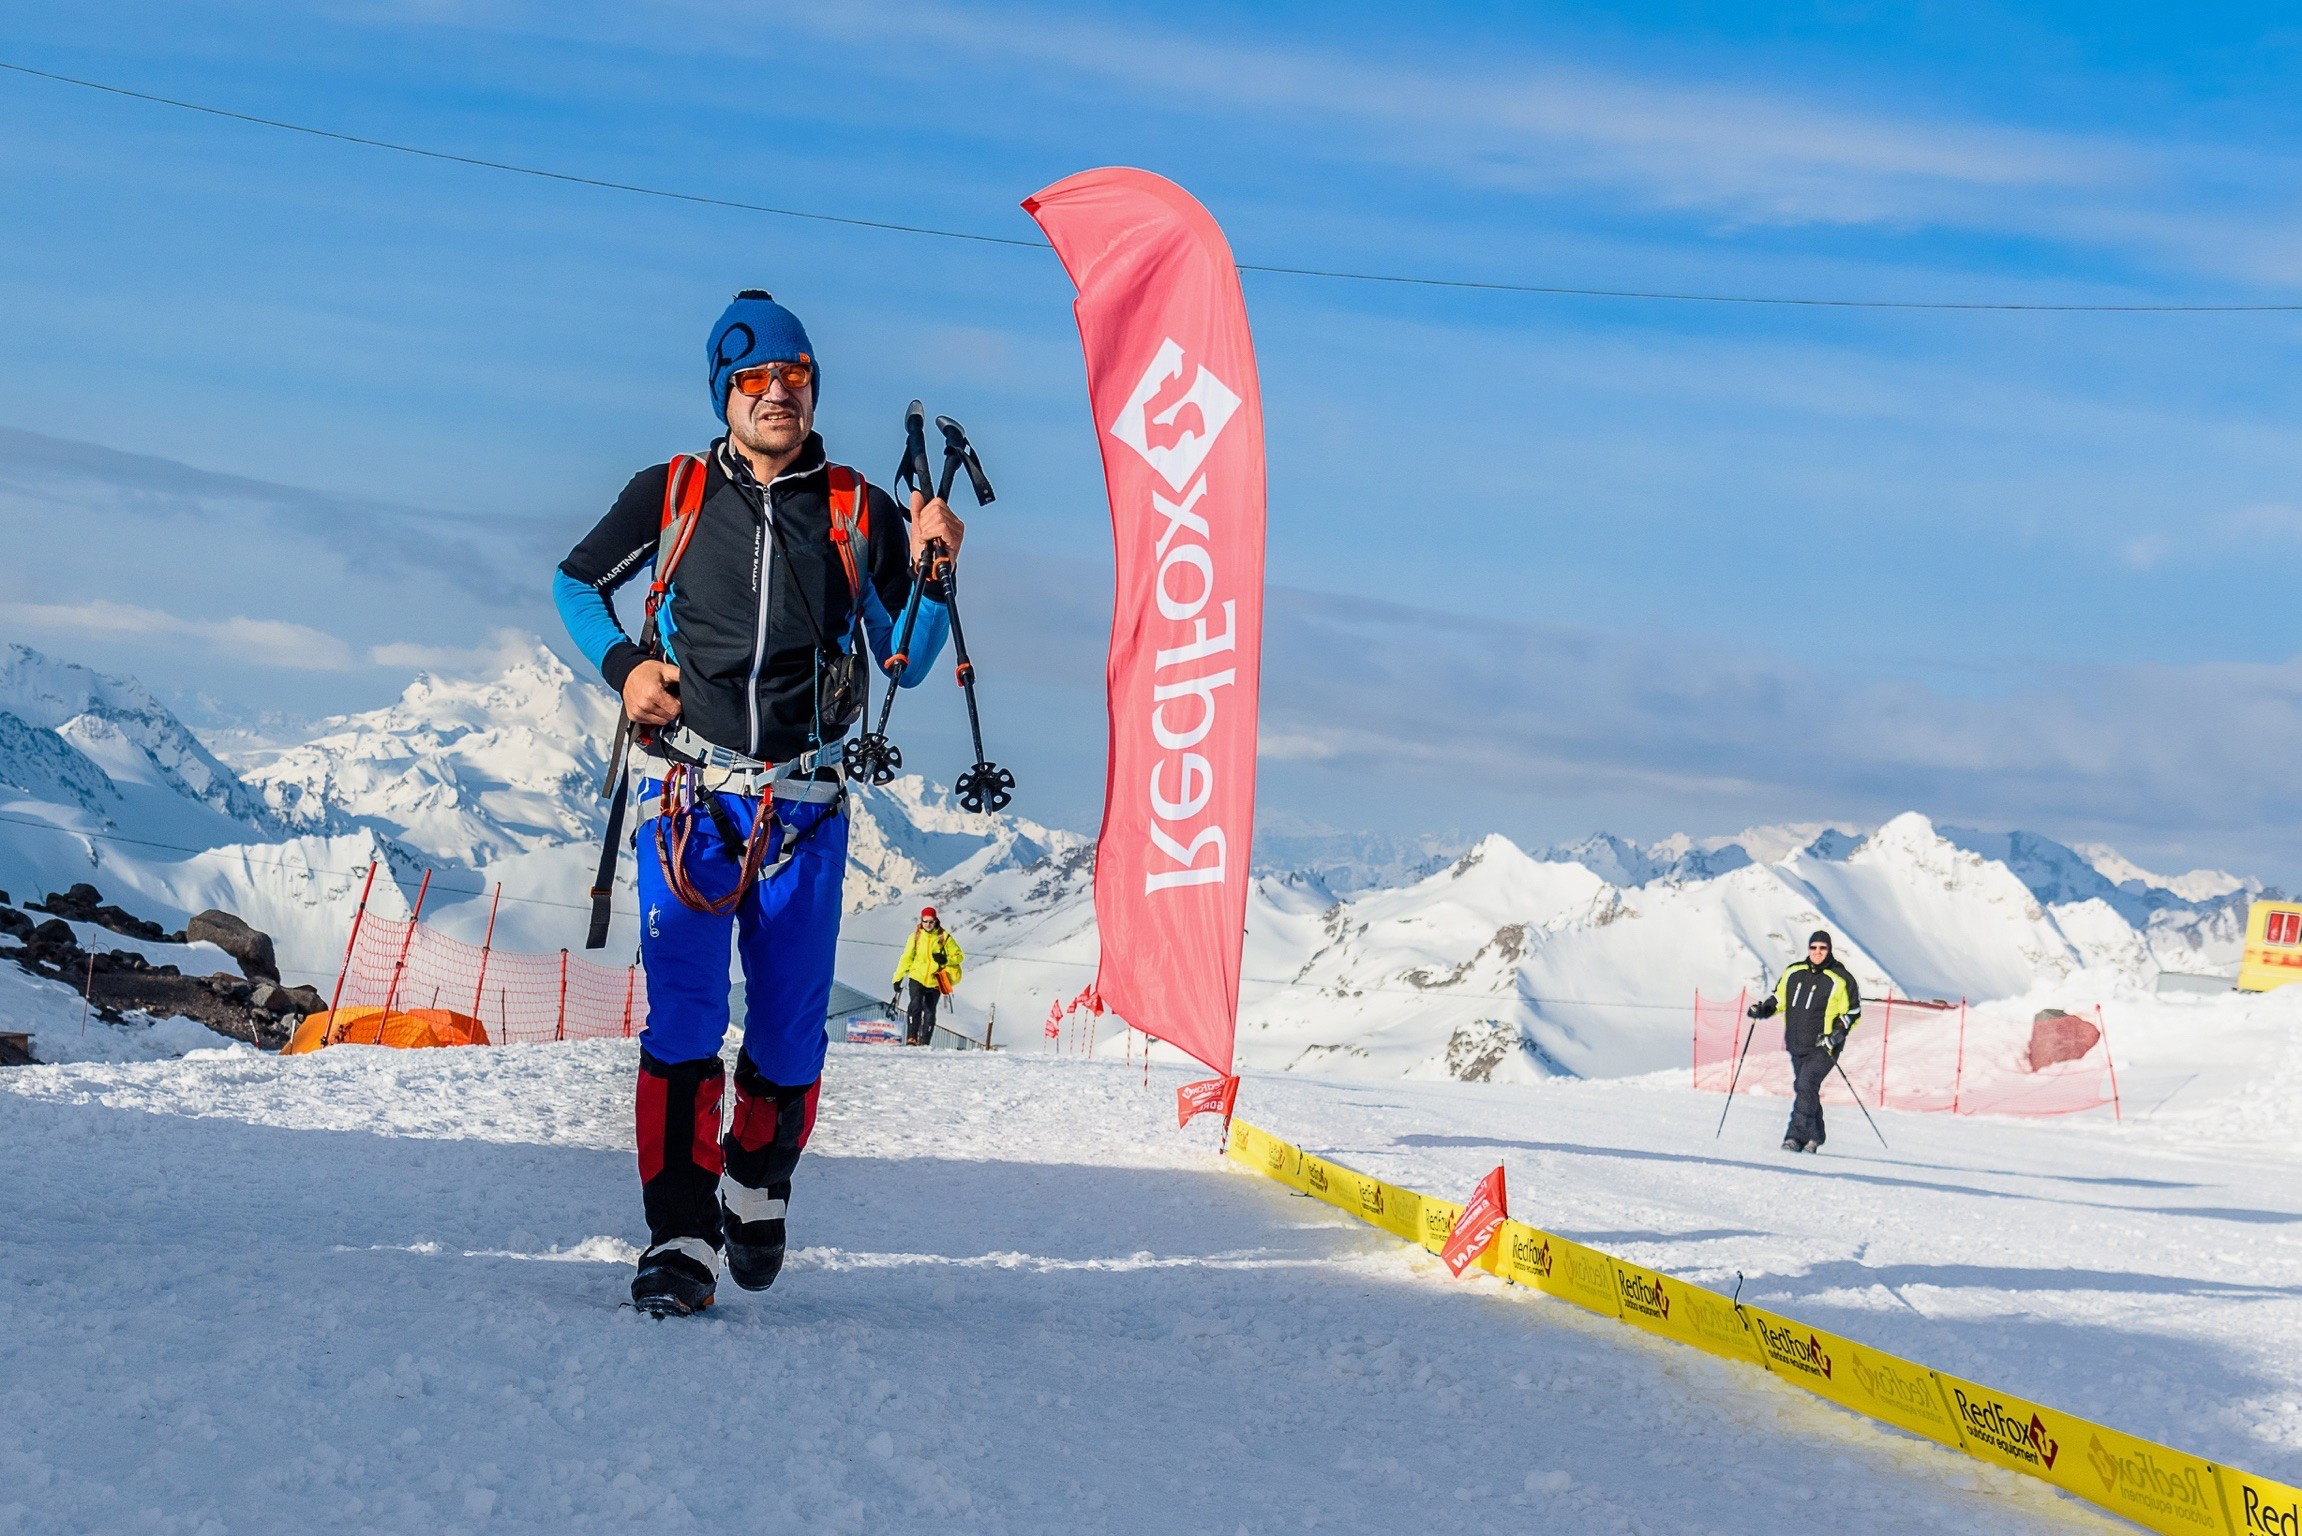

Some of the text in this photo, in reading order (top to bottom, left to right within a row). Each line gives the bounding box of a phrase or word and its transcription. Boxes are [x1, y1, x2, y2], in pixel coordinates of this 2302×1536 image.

[597, 553, 637, 586] MARTINI
[751, 558, 759, 593] ACTIVE
[1512, 1234, 1543, 1266] RedFox
[1618, 1269, 1658, 1307] RedFox
[1757, 1318, 1816, 1364] RedFox
[1954, 1388, 2035, 1449] RedFox
[1966, 1425, 2039, 1466] outdoor equipment
